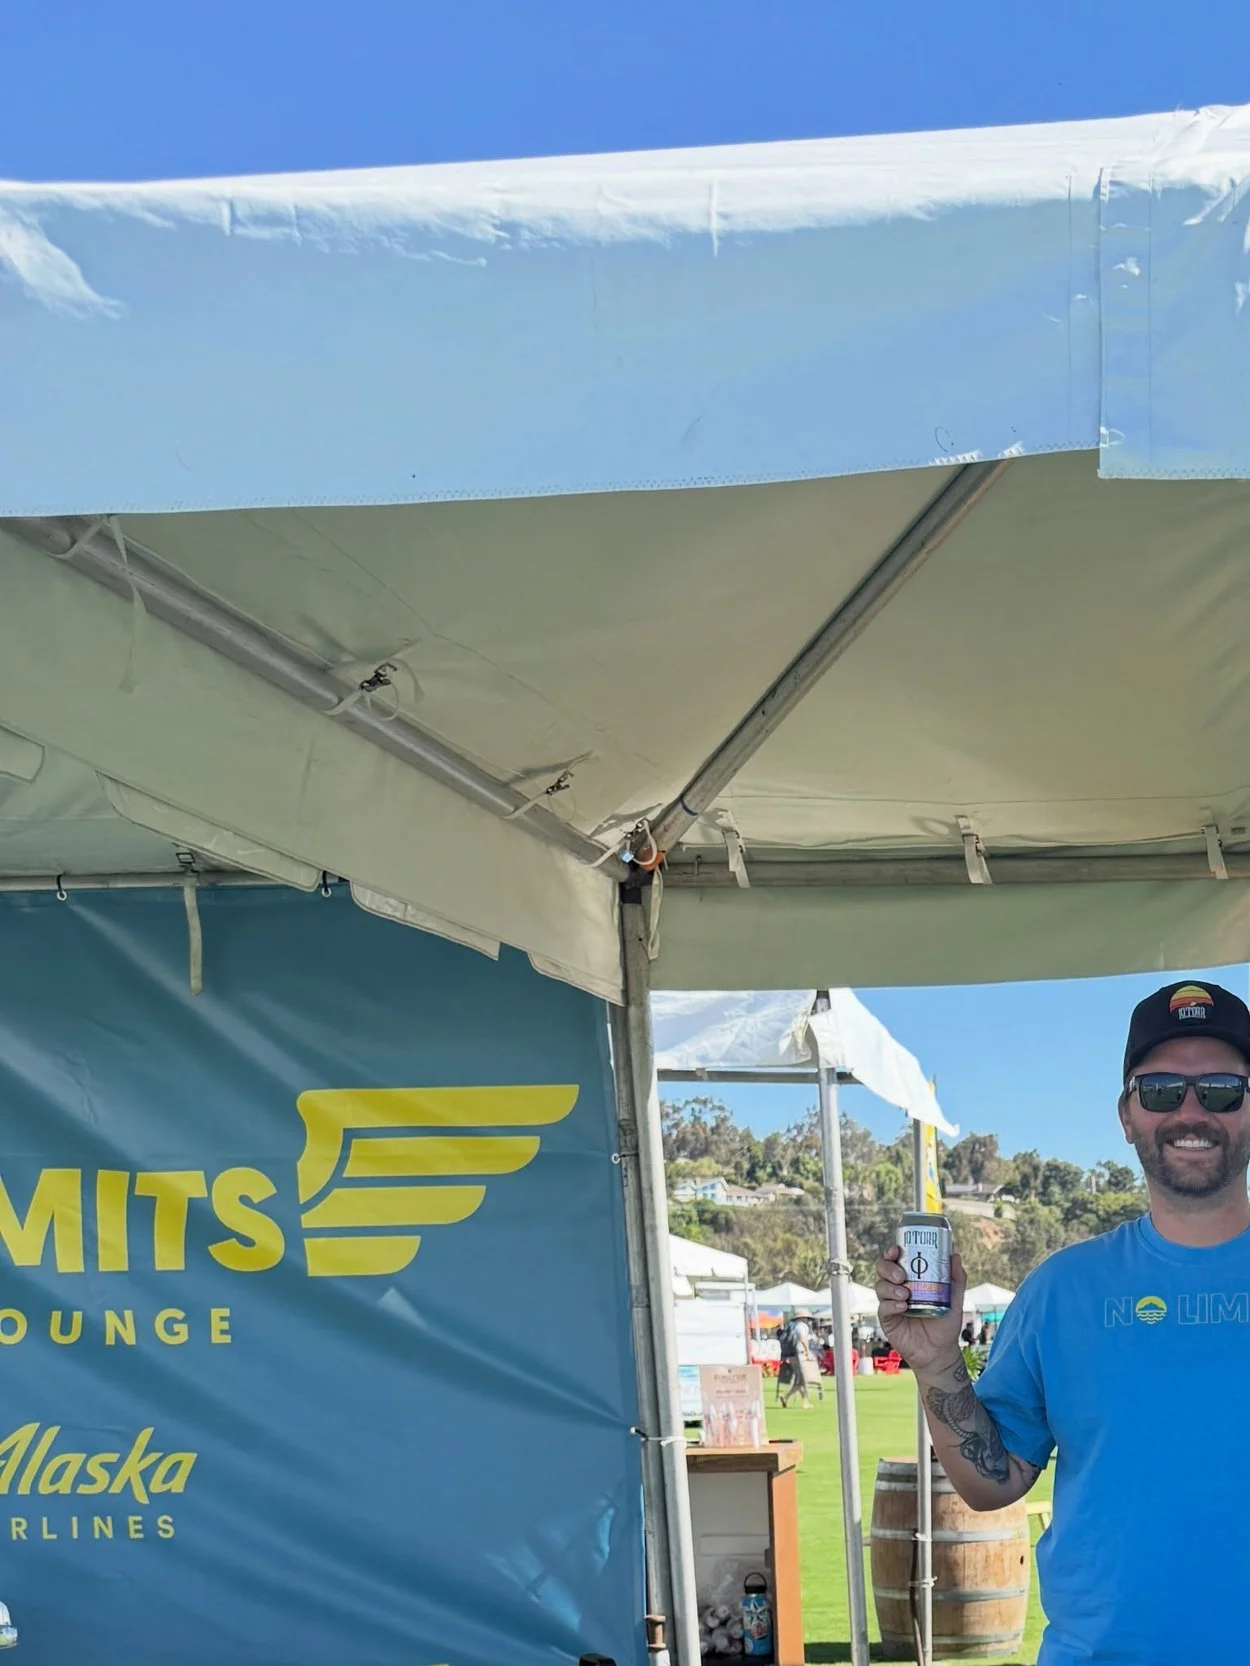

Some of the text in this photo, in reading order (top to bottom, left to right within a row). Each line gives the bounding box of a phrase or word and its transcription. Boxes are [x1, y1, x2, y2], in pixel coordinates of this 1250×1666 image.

[0, 1168, 285, 1272] MITS
[0, 1308, 232, 1346] OUNGE
[0, 1422, 198, 1504] Alaska
